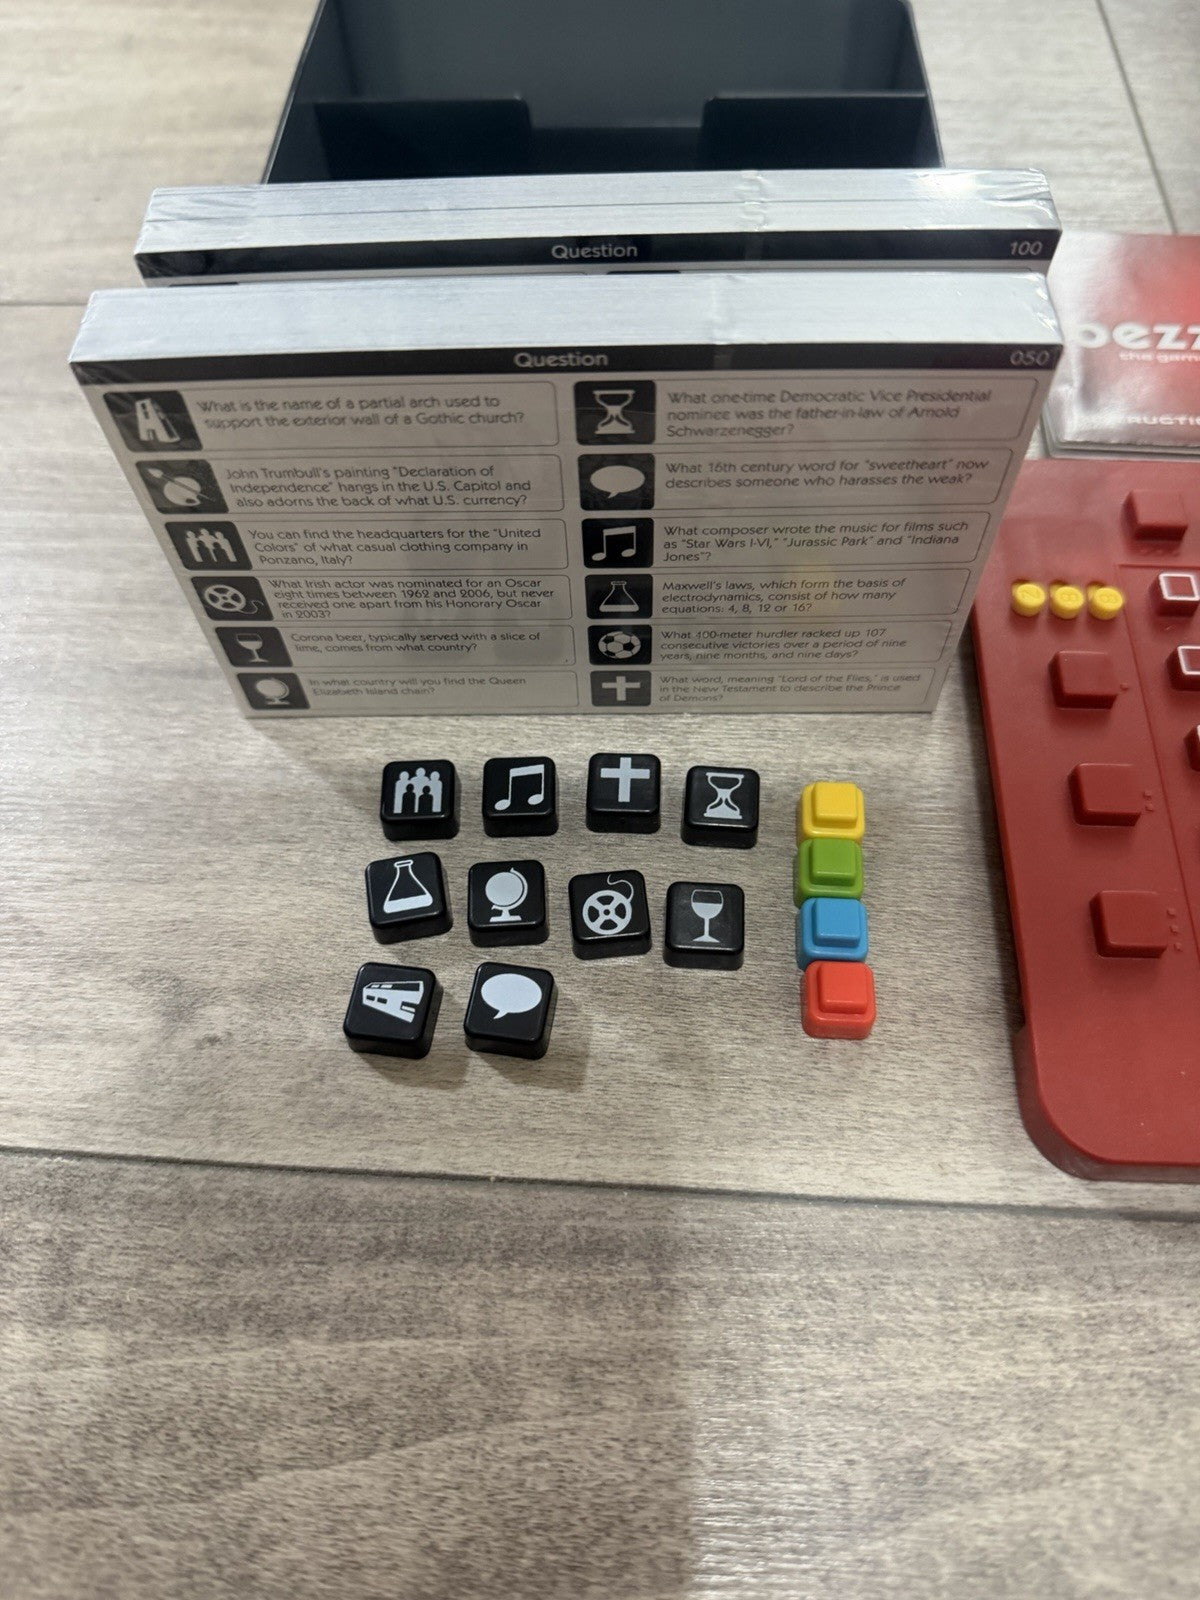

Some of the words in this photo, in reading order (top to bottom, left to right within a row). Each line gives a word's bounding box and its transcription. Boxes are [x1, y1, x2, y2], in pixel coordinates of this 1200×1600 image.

[551, 243, 638, 260] Question
[1009, 240, 1043, 256] 100
[513, 351, 608, 369] Question
[1009, 349, 1050, 366] 050
[196, 398, 236, 412] What
[239, 399, 252, 411] is
[253, 398, 279, 411] the
[281, 400, 323, 410] name
[325, 396, 340, 410] of
[345, 399, 355, 409] a
[358, 395, 405, 412] partial
[408, 394, 440, 408] arch
[444, 394, 480, 407] used
[483, 394, 500, 406] to
[204, 415, 262, 430] support
[264, 414, 290, 427] the
[291, 414, 346, 426] exterior
[349, 412, 380, 425] wall
[383, 412, 399, 425] of
[402, 415, 412, 424] a
[415, 411, 465, 424] Gothic
[468, 410, 524, 423] church?
[666, 422, 794, 439] Schwarzenegger?
[226, 467, 258, 479] John
[260, 466, 330, 479] Trumbull's
[333, 466, 390, 480] painting
[392, 464, 476, 477] "Declaration
[479, 464, 494, 476] of
[665, 461, 702, 473] What
[708, 460, 736, 473] 16th
[740, 461, 794, 475] century
[797, 459, 836, 471] word
[839, 459, 859, 471] for
[865, 458, 953, 470] "sweetheart"
[955, 460, 989, 469] now
[229, 481, 332, 496] Independence"
[337, 480, 379, 494] hangs
[381, 481, 394, 492] in
[396, 480, 420, 491] the
[422, 480, 449, 491] U.S.
[452, 479, 501, 493] Capitol
[504, 478, 531, 490] and
[665, 476, 731, 488] describes
[735, 478, 799, 487] someone
[803, 474, 835, 486] who
[838, 473, 897, 486] harasses
[901, 473, 924, 485] the
[927, 472, 972, 484] weak?
[236, 496, 263, 507] also
[266, 496, 313, 507] adorns
[315, 495, 338, 506] the
[340, 495, 374, 506] back
[377, 495, 391, 506] of
[394, 494, 430, 506] what
[432, 494, 459, 505] U.S.
[462, 493, 527, 507] currency?
[247, 529, 274, 540] You
[302, 529, 329, 539] find
[331, 528, 354, 539] the
[356, 528, 443, 541] headquarters
[446, 527, 465, 538] for
[467, 527, 490, 538] the
[492, 527, 541, 538] "United
[663, 524, 697, 535] What
[701, 526, 769, 537] composer
[771, 524, 811, 534] wrote
[814, 522, 836, 533] the
[838, 523, 877, 533] music
[880, 521, 901, 532] for
[903, 521, 934, 532] films
[937, 520, 968, 531] such
[254, 542, 298, 552] Colors"
[302, 542, 316, 552] of
[319, 541, 353, 552] what
[355, 541, 396, 551] casual
[399, 540, 451, 553] clothing
[453, 543, 513, 553] company
[516, 541, 528, 550] in
[681, 538, 710, 548] "Star
[714, 537, 746, 548] Wars
[782, 536, 837, 547] "Jurassic
[840, 535, 873, 546] Park"
[876, 535, 903, 545] and
[907, 534, 959, 545] "Indiana
[258, 554, 318, 566] Ponzano,
[320, 554, 352, 566] Italy?
[663, 550, 711, 561] Jones"?
[267, 579, 302, 589] What
[304, 579, 331, 588] Irish
[333, 580, 365, 588] actor
[396, 578, 462, 588] nominated
[464, 578, 483, 587] for
[504, 577, 541, 587] Oscar
[662, 580, 721, 590] Maxwell's
[725, 580, 755, 590] laws,
[759, 579, 797, 589] which
[800, 578, 829, 588] form
[832, 578, 853, 588] the
[856, 578, 888, 587] basis
[891, 577, 907, 587] of
[273, 590, 304, 601] eight
[305, 590, 340, 599] times
[341, 589, 397, 599] between
[401, 589, 429, 598] 1962
[432, 589, 456, 598] and
[459, 589, 493, 599] 2006,
[495, 588, 517, 598] but
[520, 590, 554, 598] never
[661, 591, 763, 604] electrodynamics,
[767, 592, 811, 600] consist
[813, 591, 828, 600] of
[830, 590, 860, 600] how
[861, 592, 896, 601] many
[277, 600, 329, 609] received
[358, 600, 391, 610] apart
[393, 599, 422, 608] from
[424, 599, 443, 608] his
[445, 599, 502, 610] Honorary
[505, 598, 541, 608] Oscar
[661, 604, 723, 615] equations:
[727, 603, 738, 613] 4,
[741, 603, 752, 612] 8,
[758, 603, 771, 612] 12
[792, 602, 812, 611] 16?
[281, 610, 293, 618] in
[294, 609, 331, 618] 2003?
[660, 630, 691, 638] What
[695, 629, 752, 638] 400-meter
[755, 628, 798, 638] hurdler
[801, 628, 841, 637] racked
[843, 630, 861, 638] up
[865, 628, 887, 636] 107
[660, 641, 729, 649] consecutive
[731, 640, 780, 648] victories
[821, 638, 863, 649] period
[865, 638, 879, 647] of
[881, 639, 907, 647] nine
